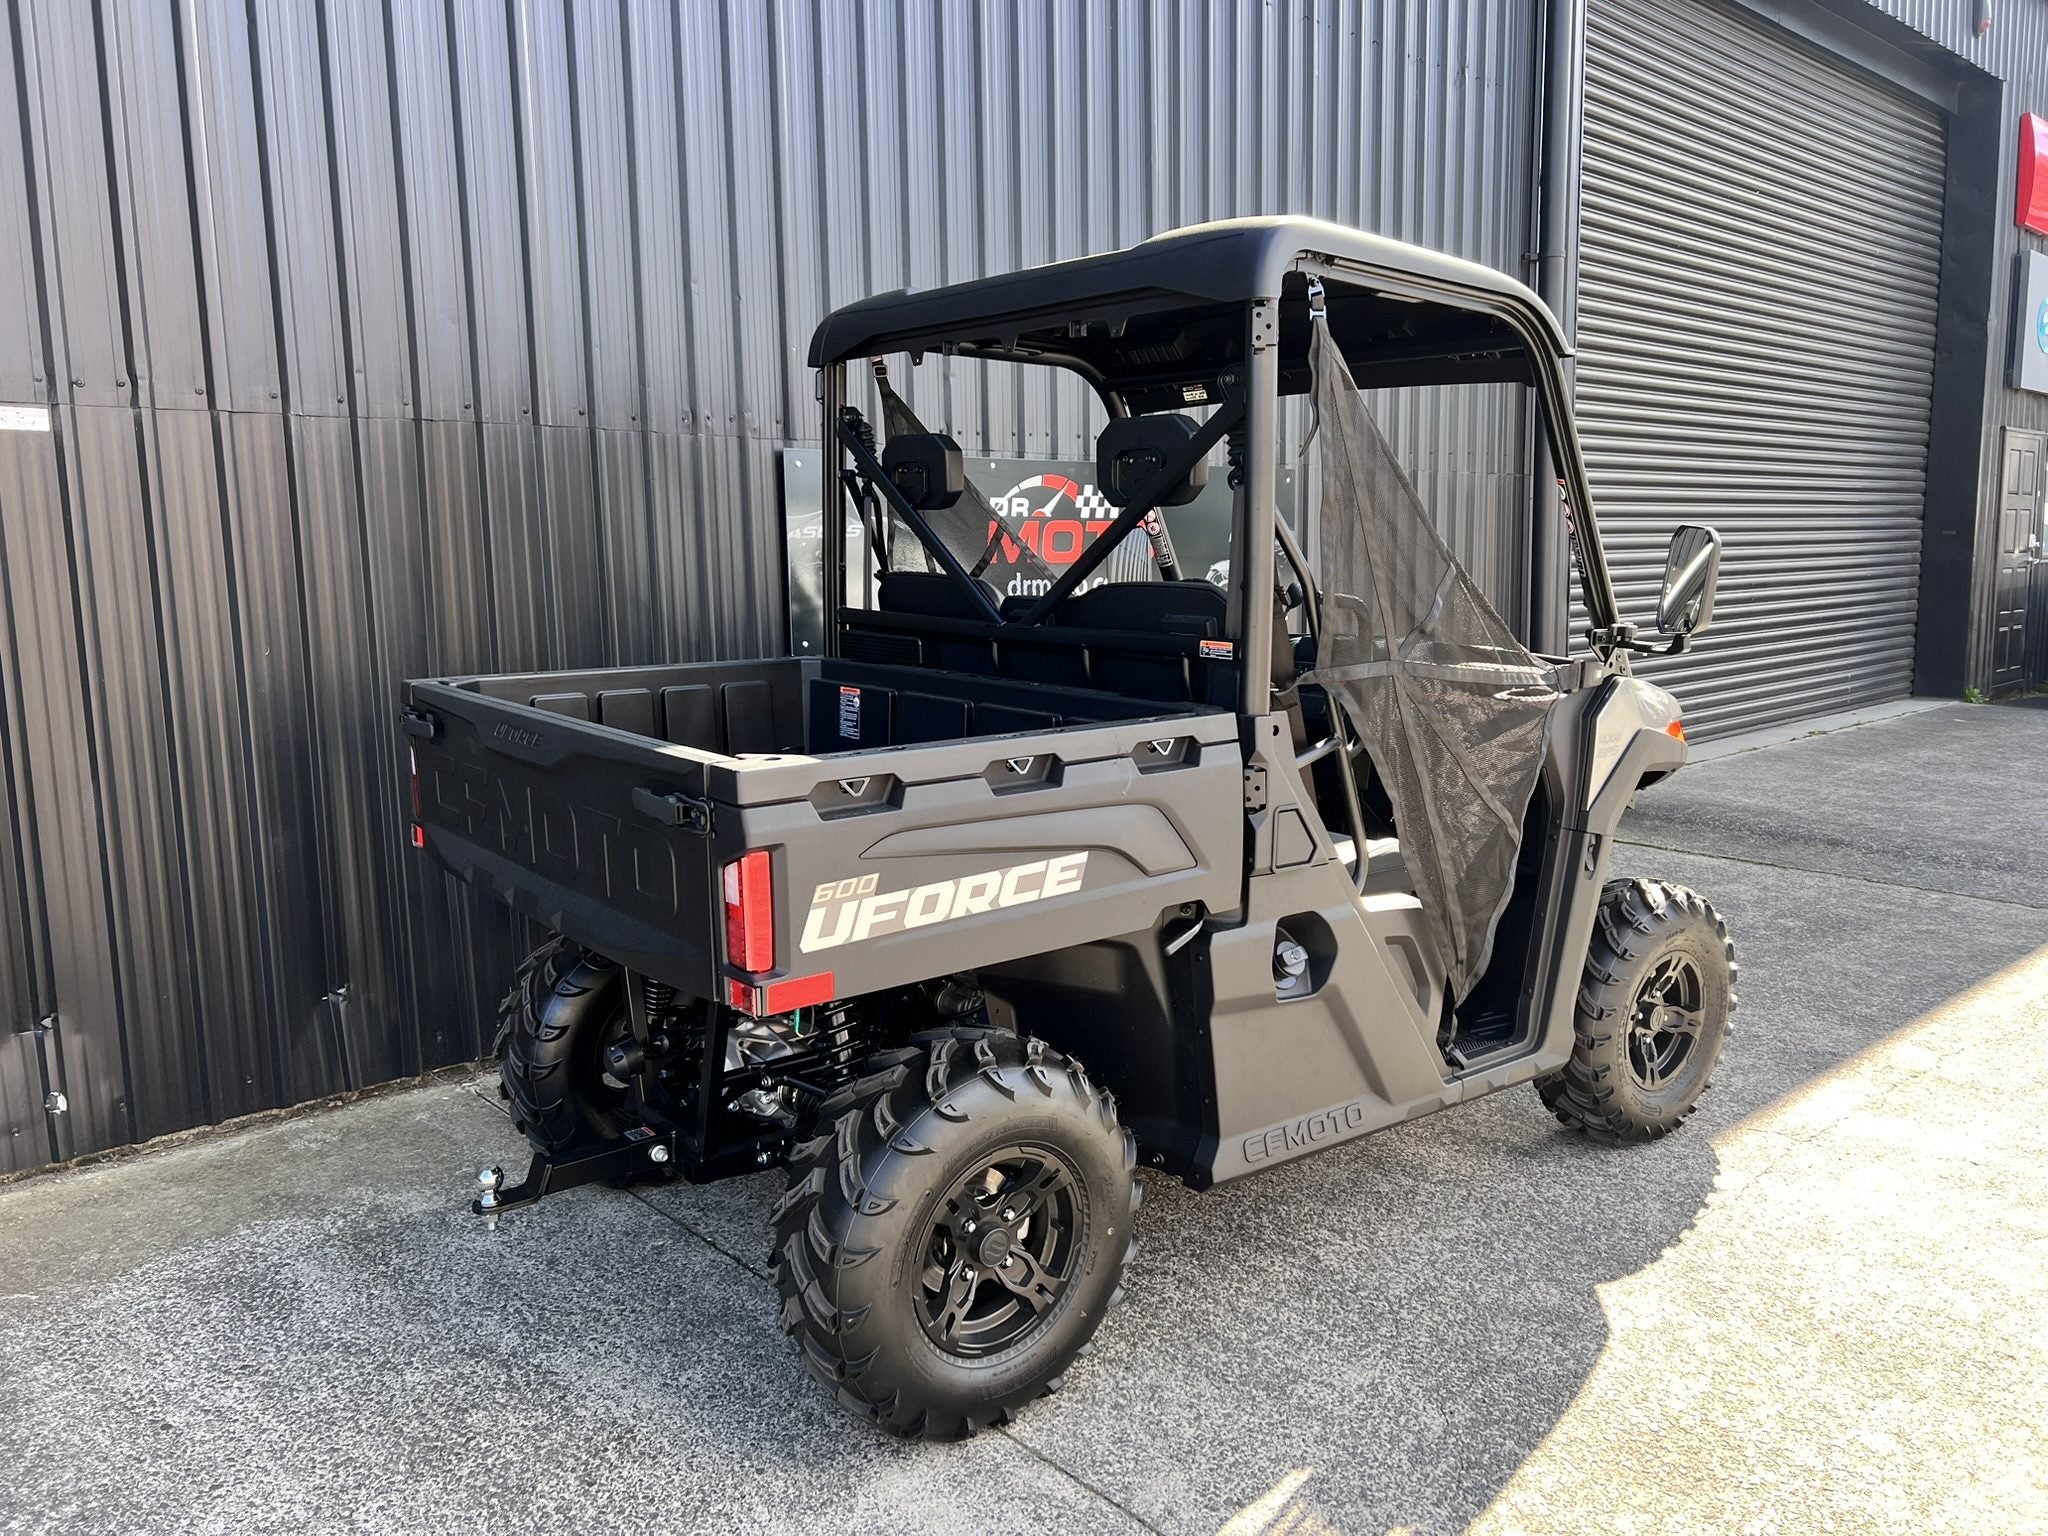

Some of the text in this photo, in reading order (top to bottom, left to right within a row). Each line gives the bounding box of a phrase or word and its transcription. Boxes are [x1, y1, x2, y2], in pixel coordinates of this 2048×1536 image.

[799, 850, 1090, 954] UFORCE
[813, 873, 881, 903] 600
[1242, 1101, 1363, 1164] CFMOTO
